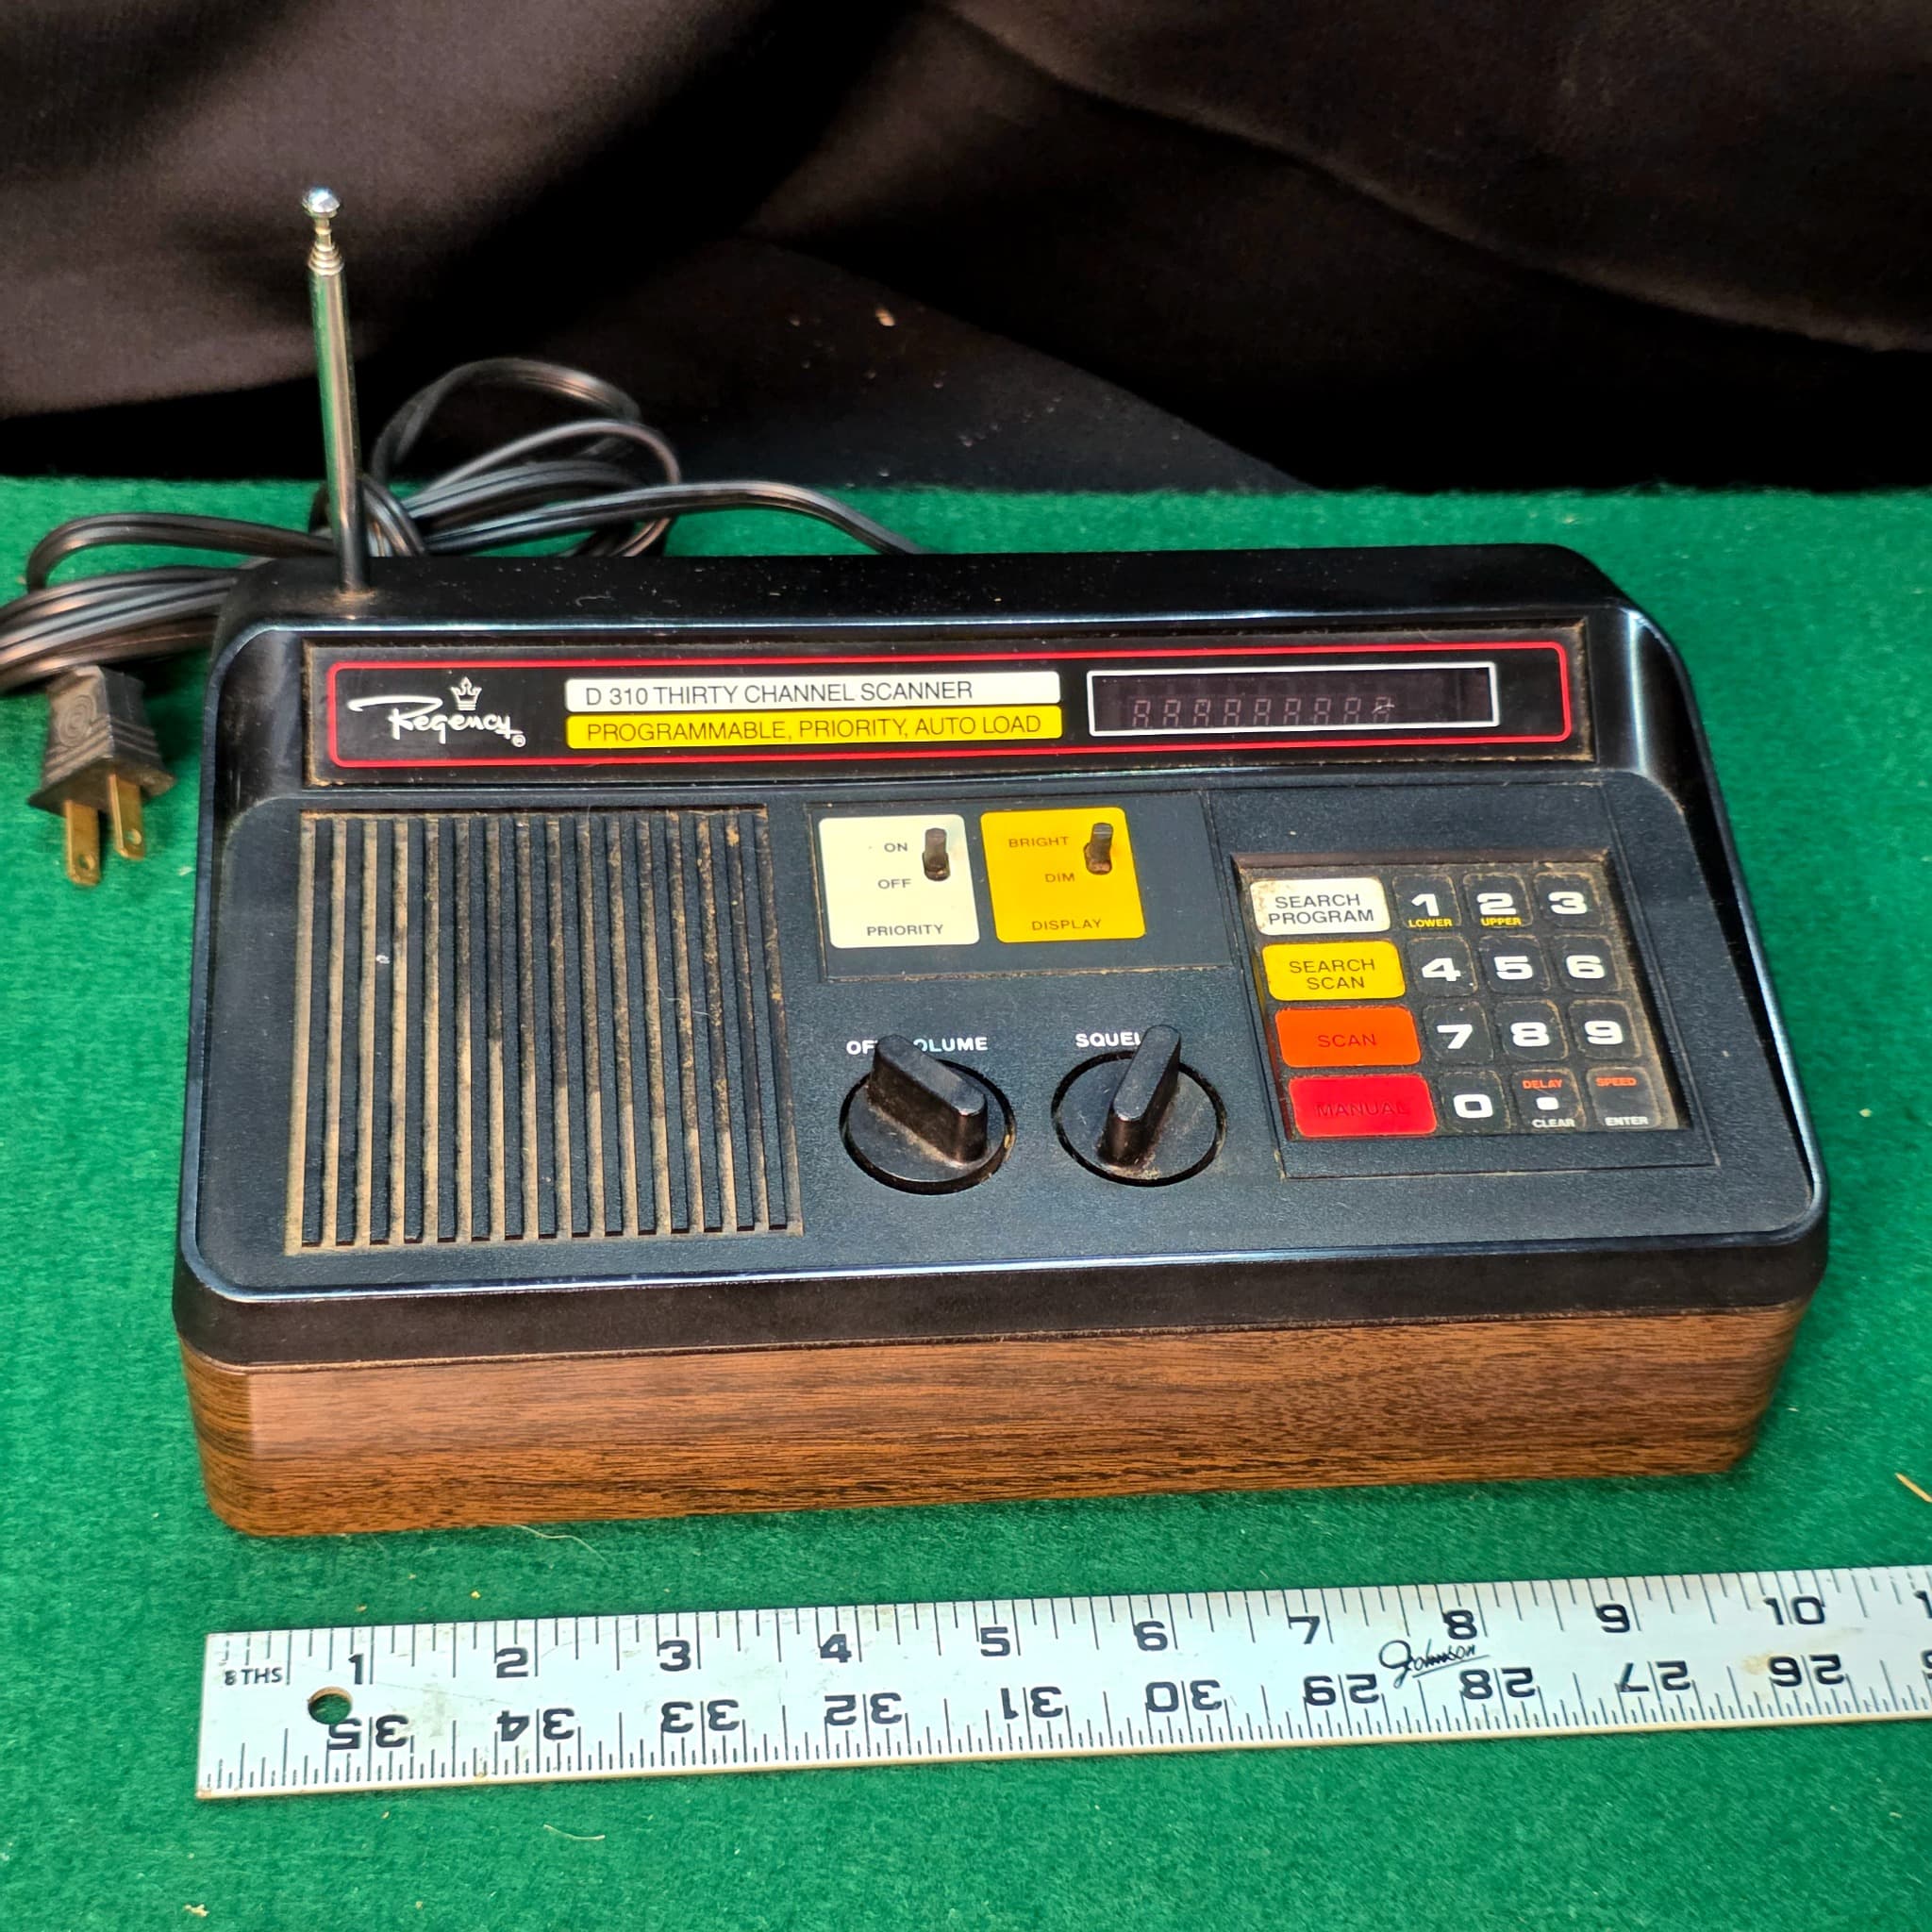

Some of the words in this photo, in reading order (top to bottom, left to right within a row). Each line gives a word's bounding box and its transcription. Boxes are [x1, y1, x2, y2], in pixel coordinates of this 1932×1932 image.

[586, 687, 602, 706] D
[609, 687, 648, 706] 310
[653, 685, 738, 706] THIRTY
[744, 682, 855, 704] CHANNEL
[860, 680, 973, 701] SCANNER
[348, 694, 524, 744] Regency
[587, 721, 792, 741] PROGRAMMABLE,
[799, 718, 908, 739] PRIORITY,
[914, 716, 975, 736] AUTO
[983, 714, 1041, 734] LOAD
[884, 842, 908, 853] ON
[1008, 836, 1070, 848] BRIGHT
[877, 878, 912, 890] OFF
[1044, 873, 1075, 883] DIM
[1275, 893, 1360, 908] SEARCH
[1411, 893, 1440, 917] 1
[1476, 891, 1517, 916] 2
[1548, 891, 1588, 915] 3
[1031, 919, 1103, 931] DISPLAY
[1268, 909, 1374, 925] PROGRAM
[1407, 918, 1453, 928] LOWER
[1480, 917, 1522, 927] UPPER
[866, 924, 944, 937] PRIORITY
[1289, 958, 1375, 974] SEARCH
[1422, 958, 1461, 982] 4
[1493, 956, 1533, 980] 5
[1566, 955, 1605, 979] 6
[1306, 976, 1365, 990] SCAN
[1317, 1034, 1377, 1048] SCAN
[1436, 1024, 1474, 1050] 7
[1510, 1022, 1551, 1047] 8
[1584, 1020, 1624, 1045] 9
[846, 1040, 877, 1055] OF
[913, 1037, 989, 1052] OLUME
[1522, 1079, 1562, 1090] DELAY
[1595, 1077, 1637, 1087] SPEED
[1316, 1101, 1410, 1118] MANUAL
[1453, 1093, 1494, 1119] 0
[1532, 1118, 1575, 1128] CLEAR
[1605, 1116, 1649, 1126] ENTER
[348, 1654, 364, 1685] 1
[495, 1647, 530, 1678] 2
[659, 1639, 691, 1672] 3
[819, 1633, 852, 1662] 4
[979, 1626, 1010, 1657] 5
[1133, 1620, 1169, 1652] 6
[1288, 1616, 1321, 1644] 7
[1442, 1609, 1477, 1640] 8
[1595, 1603, 1631, 1633] 9
[1763, 1595, 1826, 1625] 10
[1620, 1660, 1691, 1693] 27
[1769, 1654, 1844, 1687] 26
[1304, 1674, 1379, 1707] 29
[1459, 1667, 1537, 1699] 28
[1145, 1679, 1223, 1713] 30
[661, 1699, 740, 1733] 33
[824, 1692, 903, 1726] 32
[497, 1707, 575, 1742] 34
